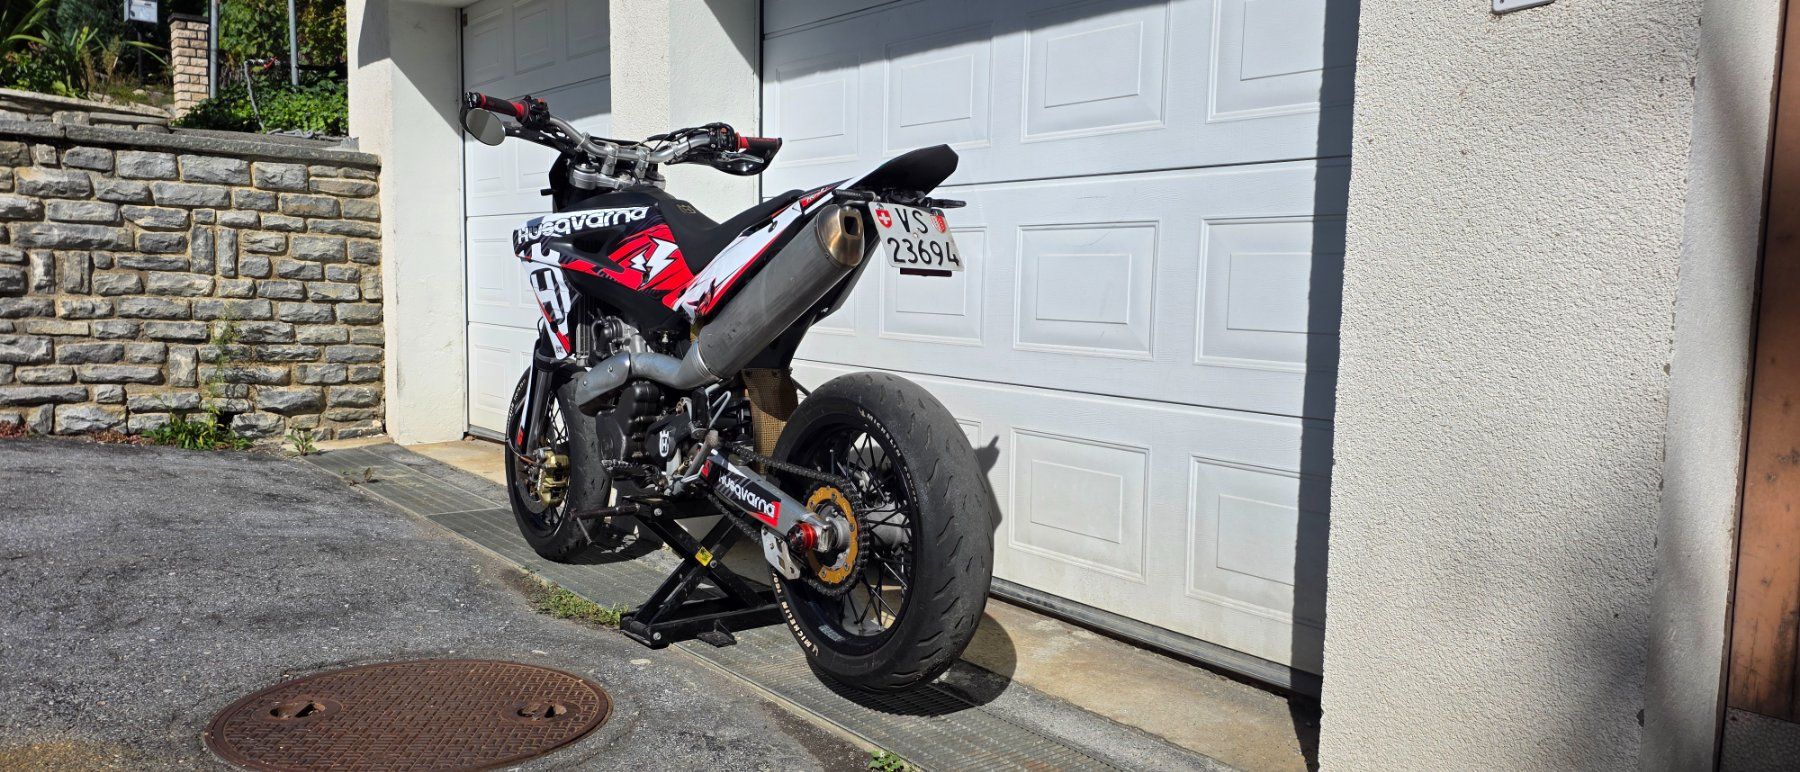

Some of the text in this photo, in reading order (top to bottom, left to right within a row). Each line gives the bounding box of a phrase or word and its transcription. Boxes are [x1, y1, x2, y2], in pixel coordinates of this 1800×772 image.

[518, 206, 650, 244] Husqvarna
[895, 208, 928, 234] VS
[887, 237, 960, 266] 23694
[866, 413, 901, 457] MICHELIN
[719, 474, 776, 518] Husqvarna
[781, 601, 813, 648] MICHELIN
